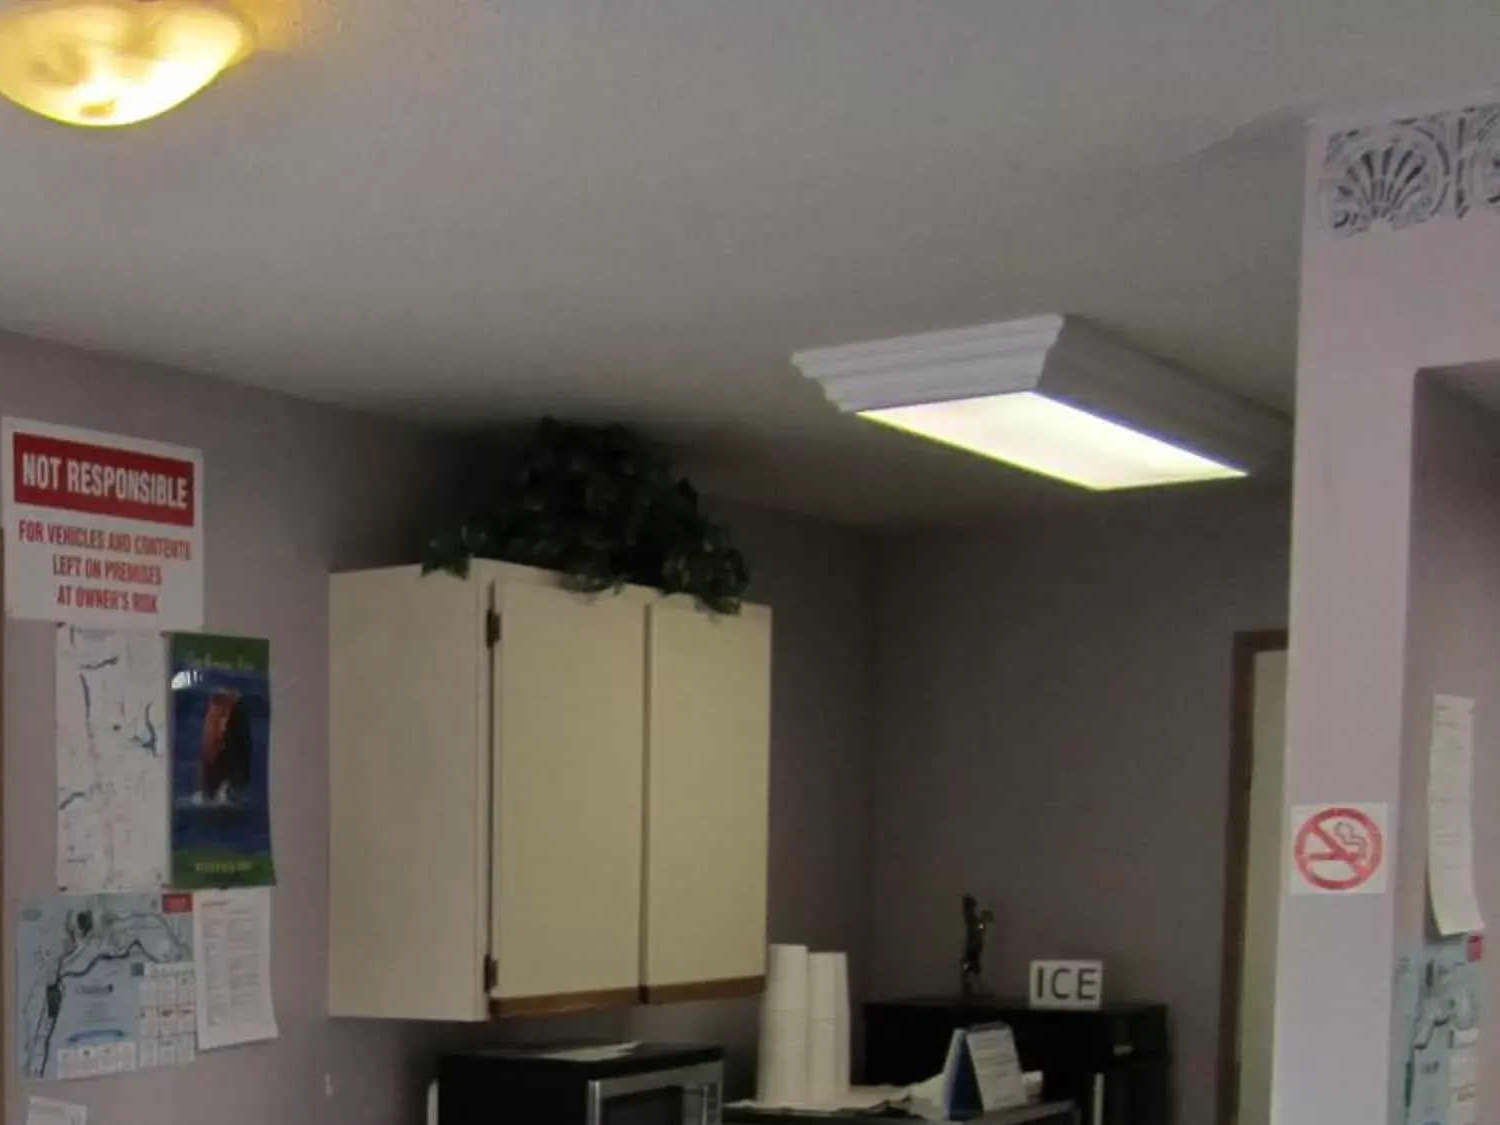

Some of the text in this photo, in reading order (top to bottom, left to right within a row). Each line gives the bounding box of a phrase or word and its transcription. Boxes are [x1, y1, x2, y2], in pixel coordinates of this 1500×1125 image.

[22, 452, 188, 510] NOT RESPONSIBLE
[19, 519, 192, 561] FOR VEHICLES AND CONTENTS
[52, 554, 162, 586] LEFT ON PREMISES
[58, 585, 159, 614] AT OWNER'S RISK
[1036, 965, 1098, 1000] ICE
